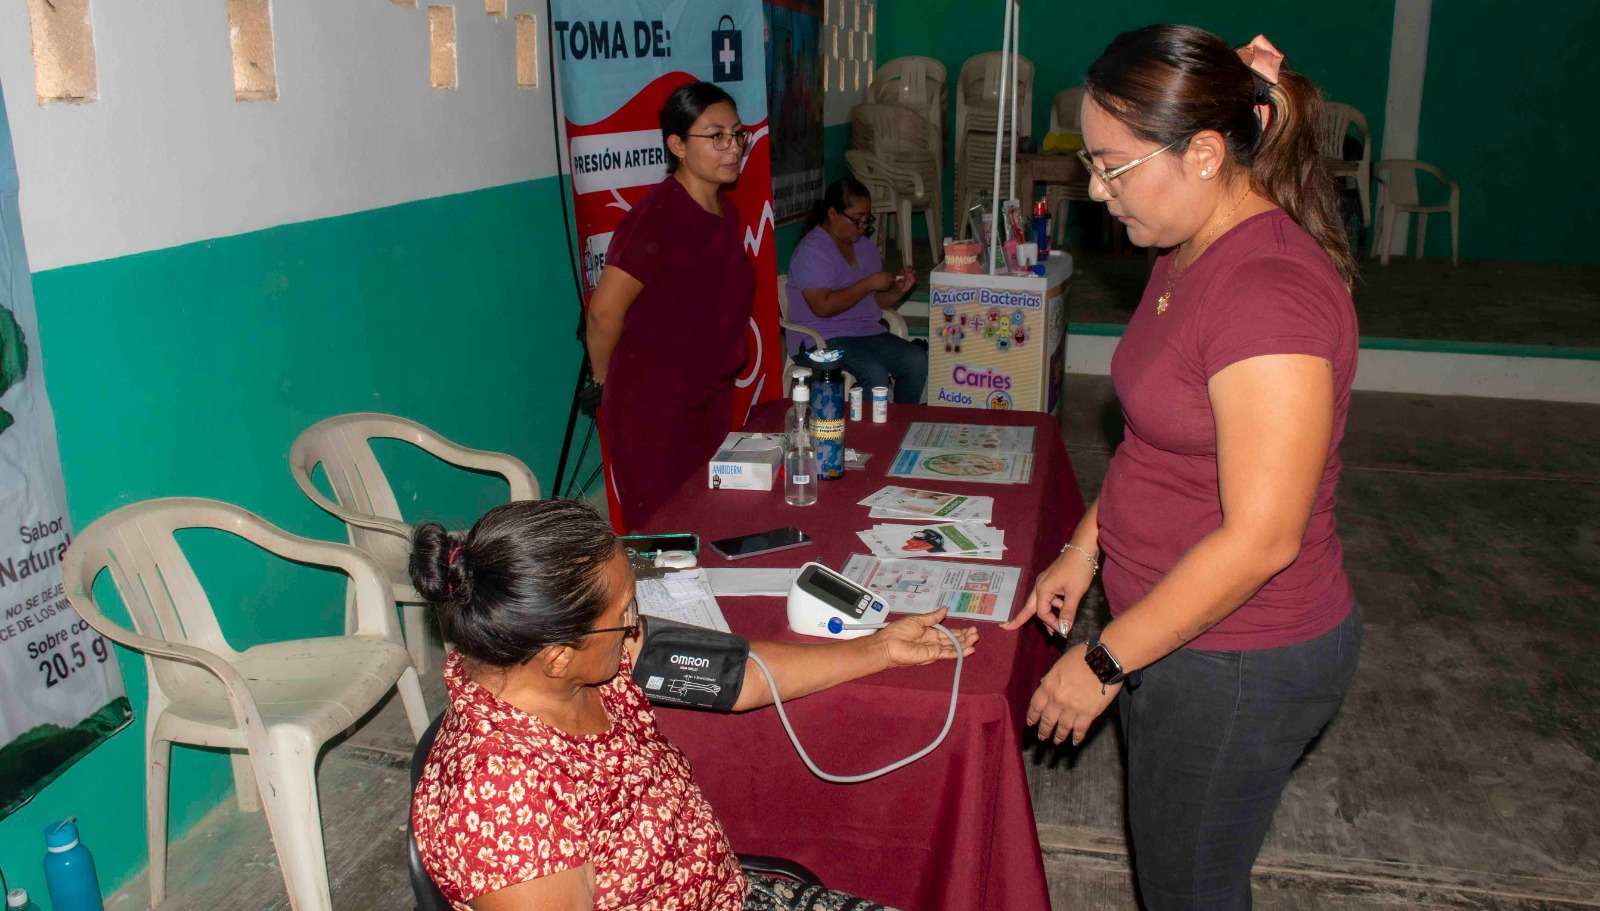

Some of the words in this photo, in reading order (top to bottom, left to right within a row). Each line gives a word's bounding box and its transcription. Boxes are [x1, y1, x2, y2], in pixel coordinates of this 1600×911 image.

[554, 20, 629, 61] TOMA
[634, 20, 671, 58] DE:
[574, 148, 621, 175] PRESIÓN
[624, 147, 669, 169] ARTERI
[932, 289, 976, 304] Azúcar
[980, 290, 1040, 308] Bacterias
[953, 365, 1011, 390] Caries
[938, 387, 972, 405] Ácidos
[712, 464, 743, 475] AMBIDERM
[20, 516, 63, 545] Sabor
[6, 603, 23, 621] NO
[25, 595, 40, 611] SE
[41, 582, 66, 603] DEJE
[16, 615, 36, 633] DE
[33, 605, 57, 623] LOS
[27, 629, 68, 660] Sobre
[71, 618, 90, 636] co
[39, 641, 86, 689] 20.5
[92, 635, 108, 664] g
[670, 654, 710, 668] OMRON
